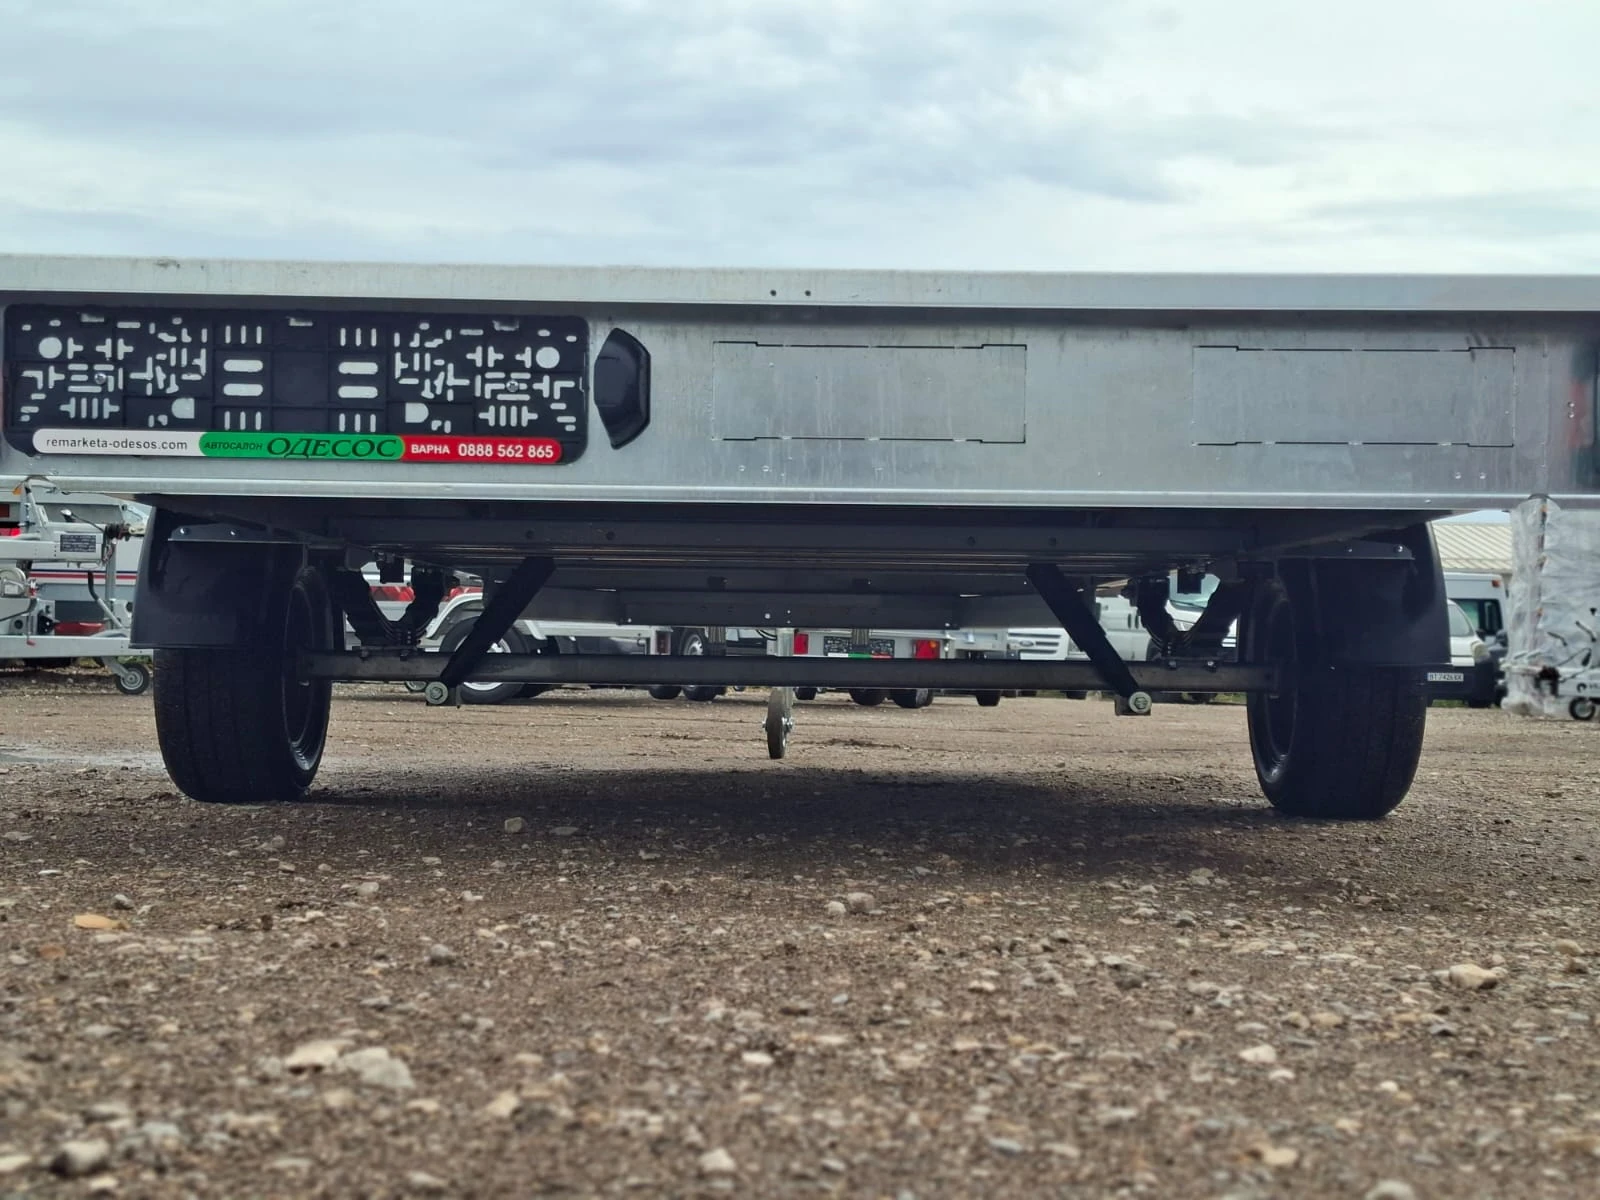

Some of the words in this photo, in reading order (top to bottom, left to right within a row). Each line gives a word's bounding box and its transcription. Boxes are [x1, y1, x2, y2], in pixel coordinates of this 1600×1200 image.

[46, 436, 188, 450] remarketa-odesos.com
[203, 441, 264, 451] АВТОСАЛОН
[266, 437, 397, 459] ОДЕСОС
[411, 444, 451, 454] ВАРНА
[458, 443, 494, 457] 0888
[497, 444, 524, 458] 562
[527, 445, 555, 459] 865
